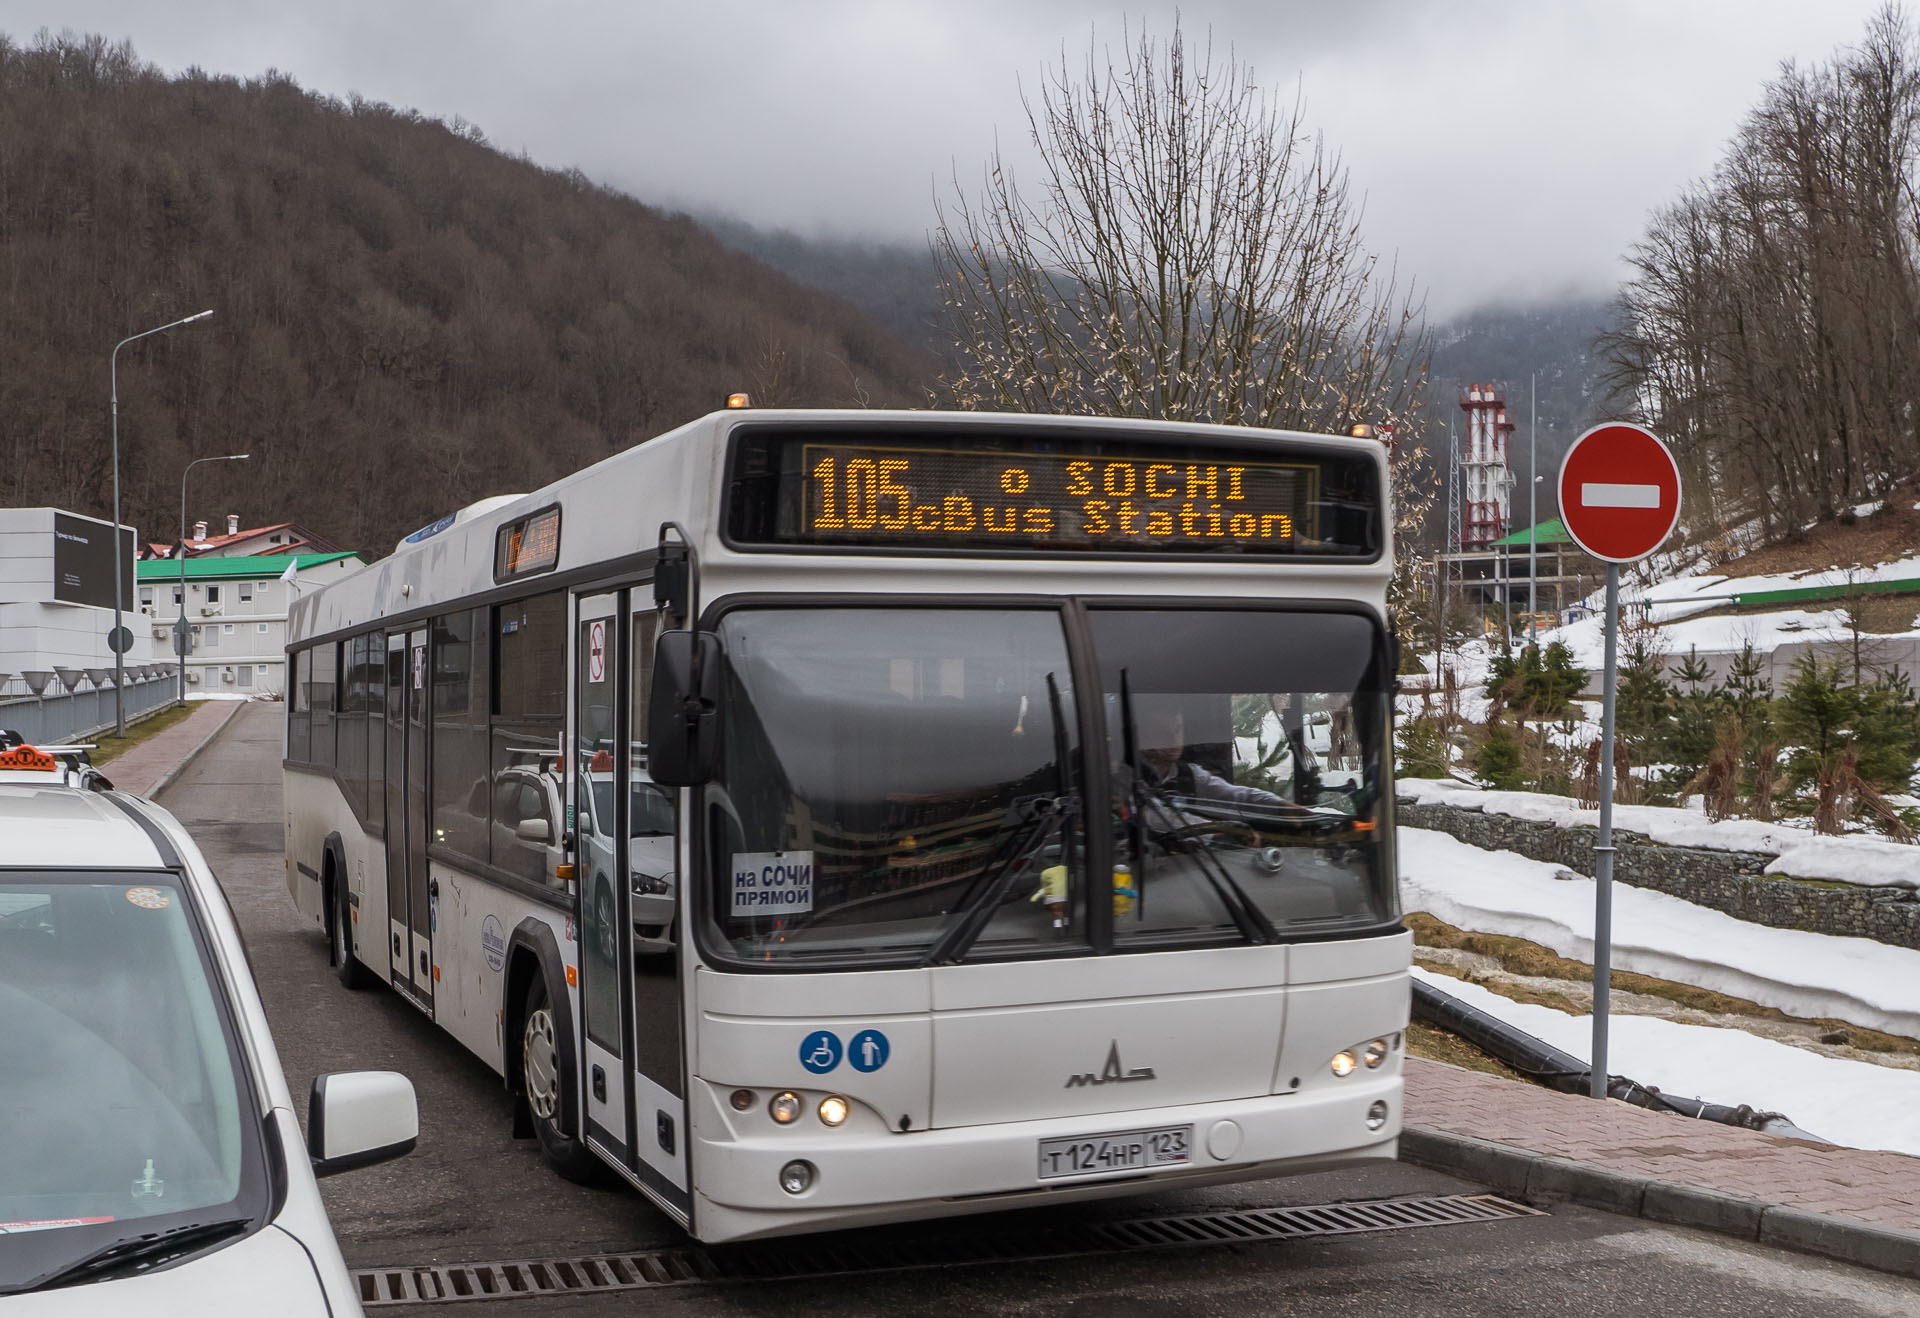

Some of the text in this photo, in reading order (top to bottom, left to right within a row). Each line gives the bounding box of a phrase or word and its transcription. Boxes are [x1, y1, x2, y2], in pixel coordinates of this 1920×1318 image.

[813, 457, 909, 530] 105
[1065, 461, 1245, 500] SOCHI
[1083, 501, 1292, 538] Station
[736, 865, 810, 887] на СОЧИ
[735, 887, 810, 906] ПРЯМОЙ
[1148, 1132, 1187, 1153] 123
